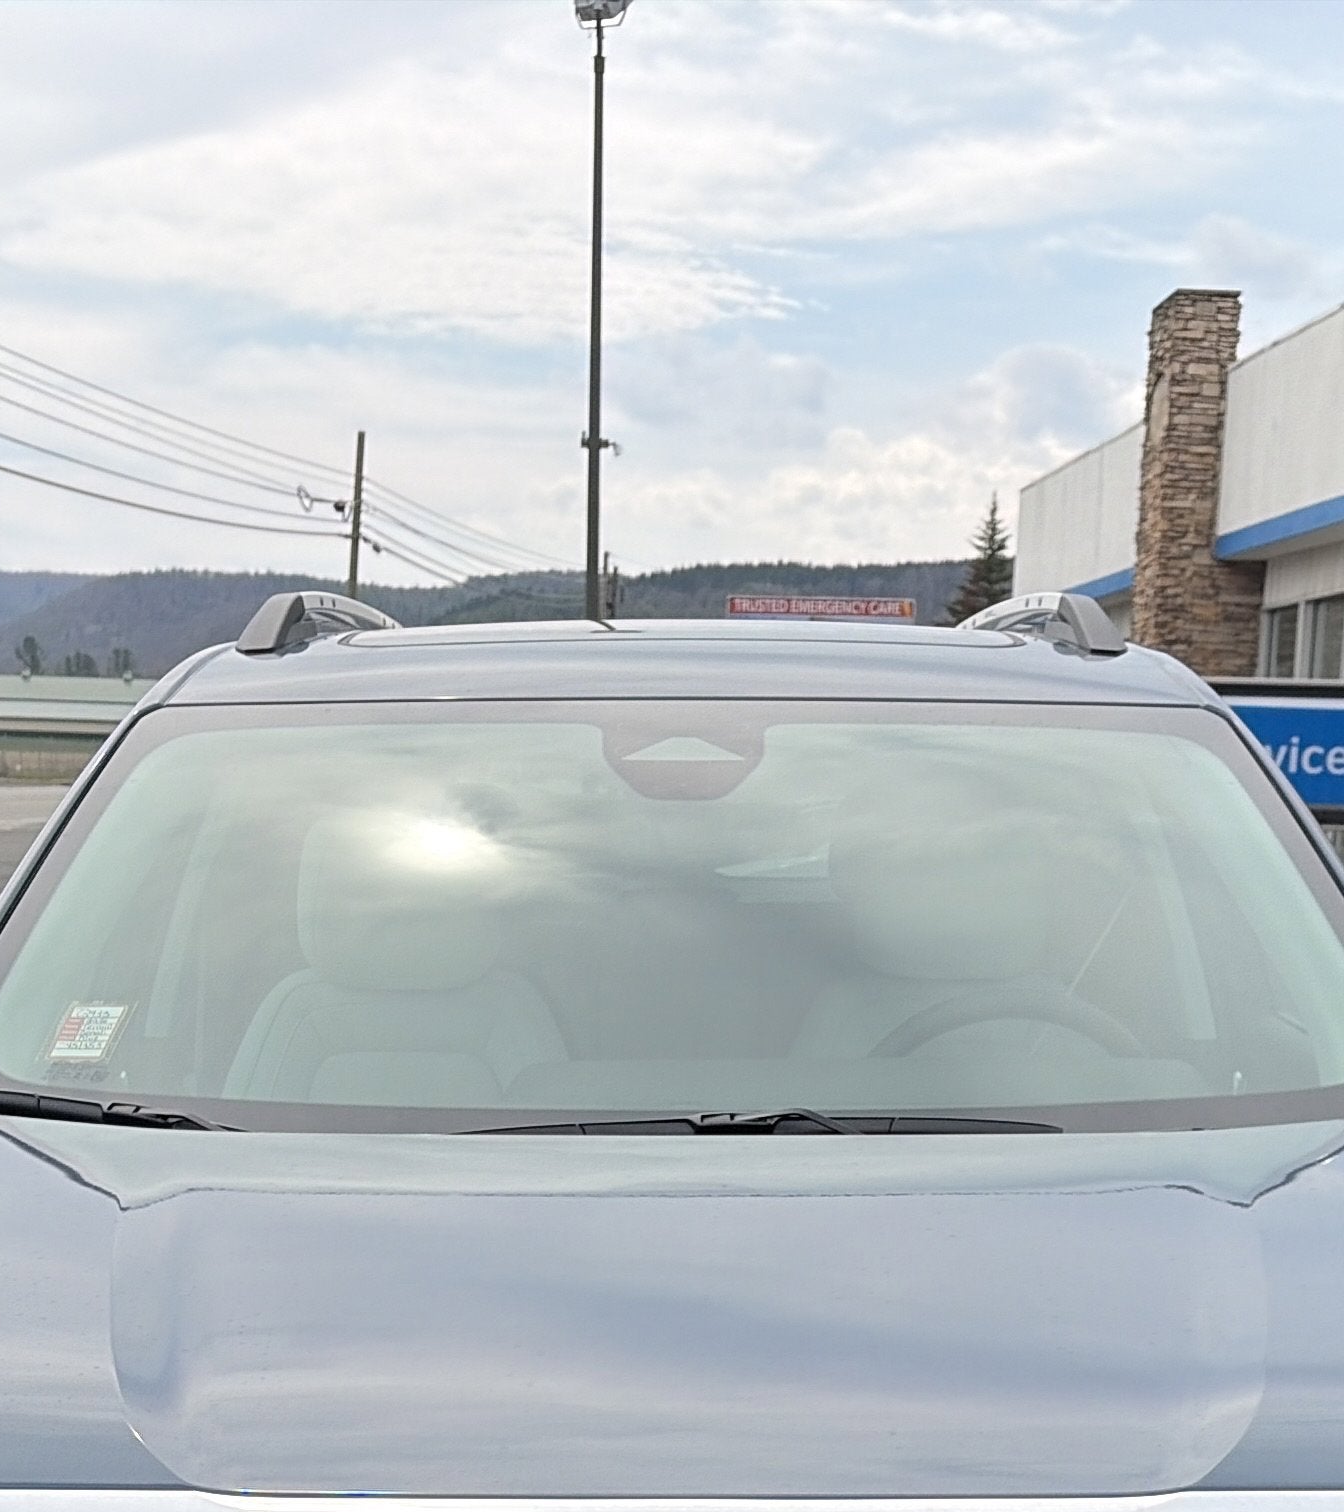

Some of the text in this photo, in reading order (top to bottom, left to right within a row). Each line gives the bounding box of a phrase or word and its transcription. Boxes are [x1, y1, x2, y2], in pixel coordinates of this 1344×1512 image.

[735, 598, 902, 615] TRUSTED EMERGENCY CARE
